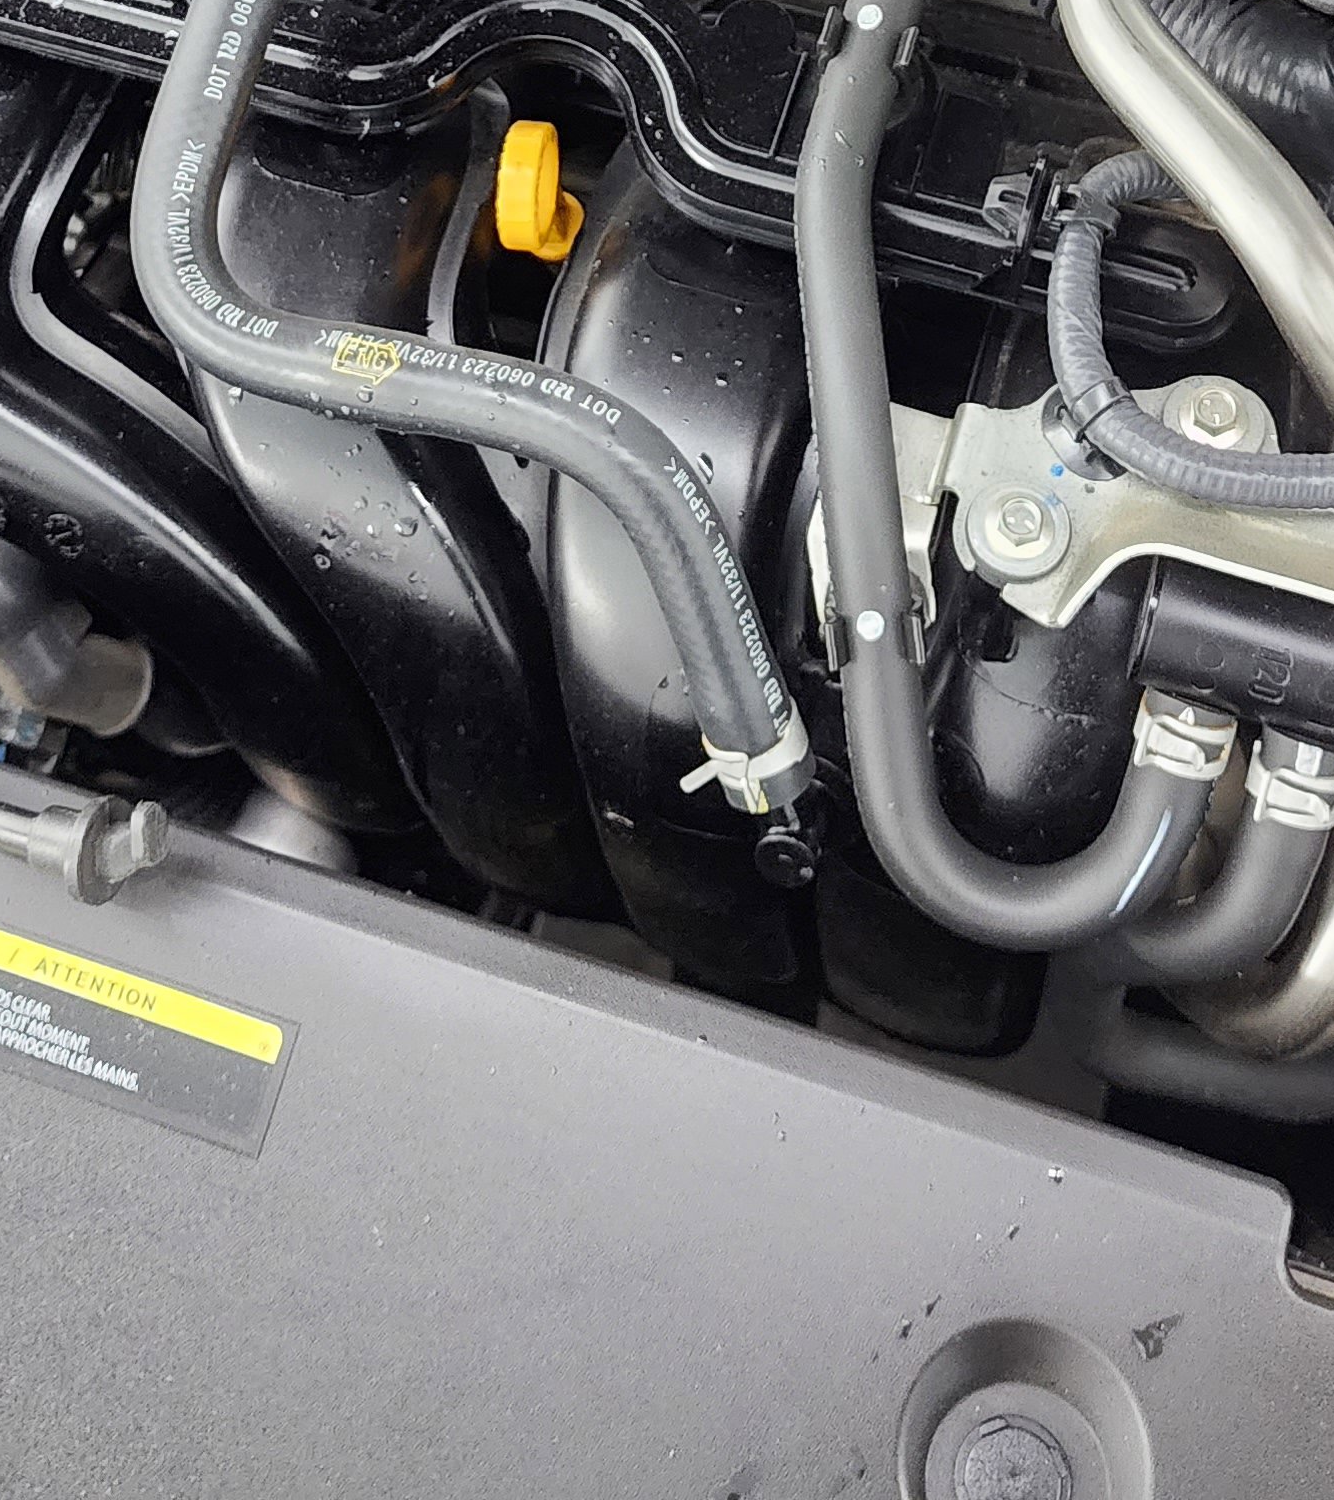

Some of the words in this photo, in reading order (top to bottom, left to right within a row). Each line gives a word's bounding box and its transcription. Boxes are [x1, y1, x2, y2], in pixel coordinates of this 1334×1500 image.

[204, 64, 231, 100] DOT
[171, 138, 206, 203] >EPDM<
[177, 262, 222, 311] 060223
[240, 315, 280, 339] DOT
[461, 357, 536, 389] 060223
[578, 393, 623, 425] DOT
[664, 456, 717, 536] >EPDM<
[738, 607, 772, 679] 060223
[33, 957, 157, 1011] ATTENTION
